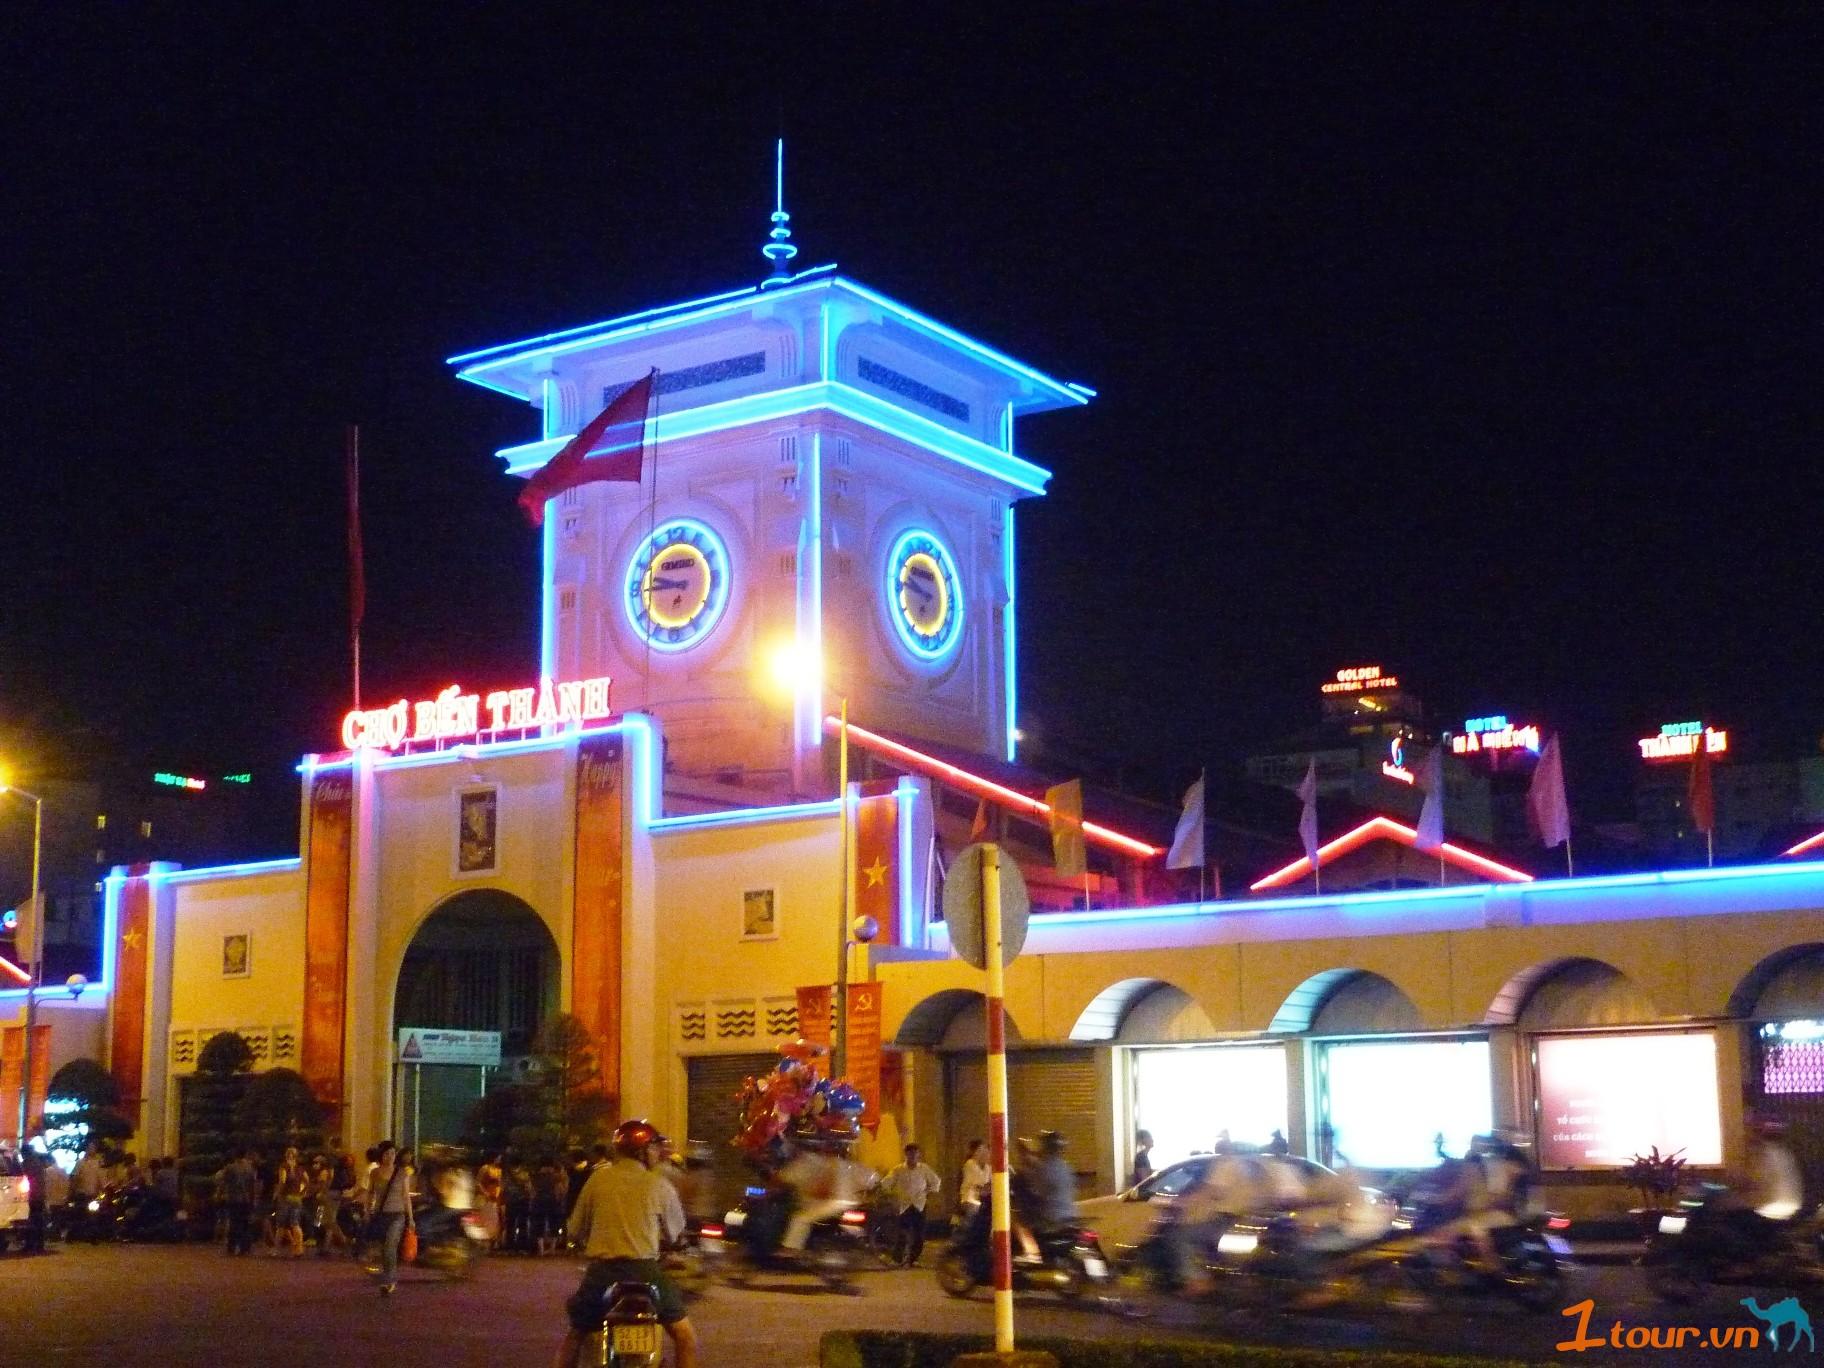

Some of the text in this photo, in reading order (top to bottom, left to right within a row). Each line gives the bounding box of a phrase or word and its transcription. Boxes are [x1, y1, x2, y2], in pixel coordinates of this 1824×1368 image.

[1336, 666, 1380, 682] GOLDEN
[1321, 677, 1398, 693] CENTRAL HOTEL
[342, 699, 408, 750] CHỢ
[415, 684, 480, 740] BẾN
[1465, 716, 1506, 733] HOTEL
[1661, 721, 1703, 736] HOTEL
